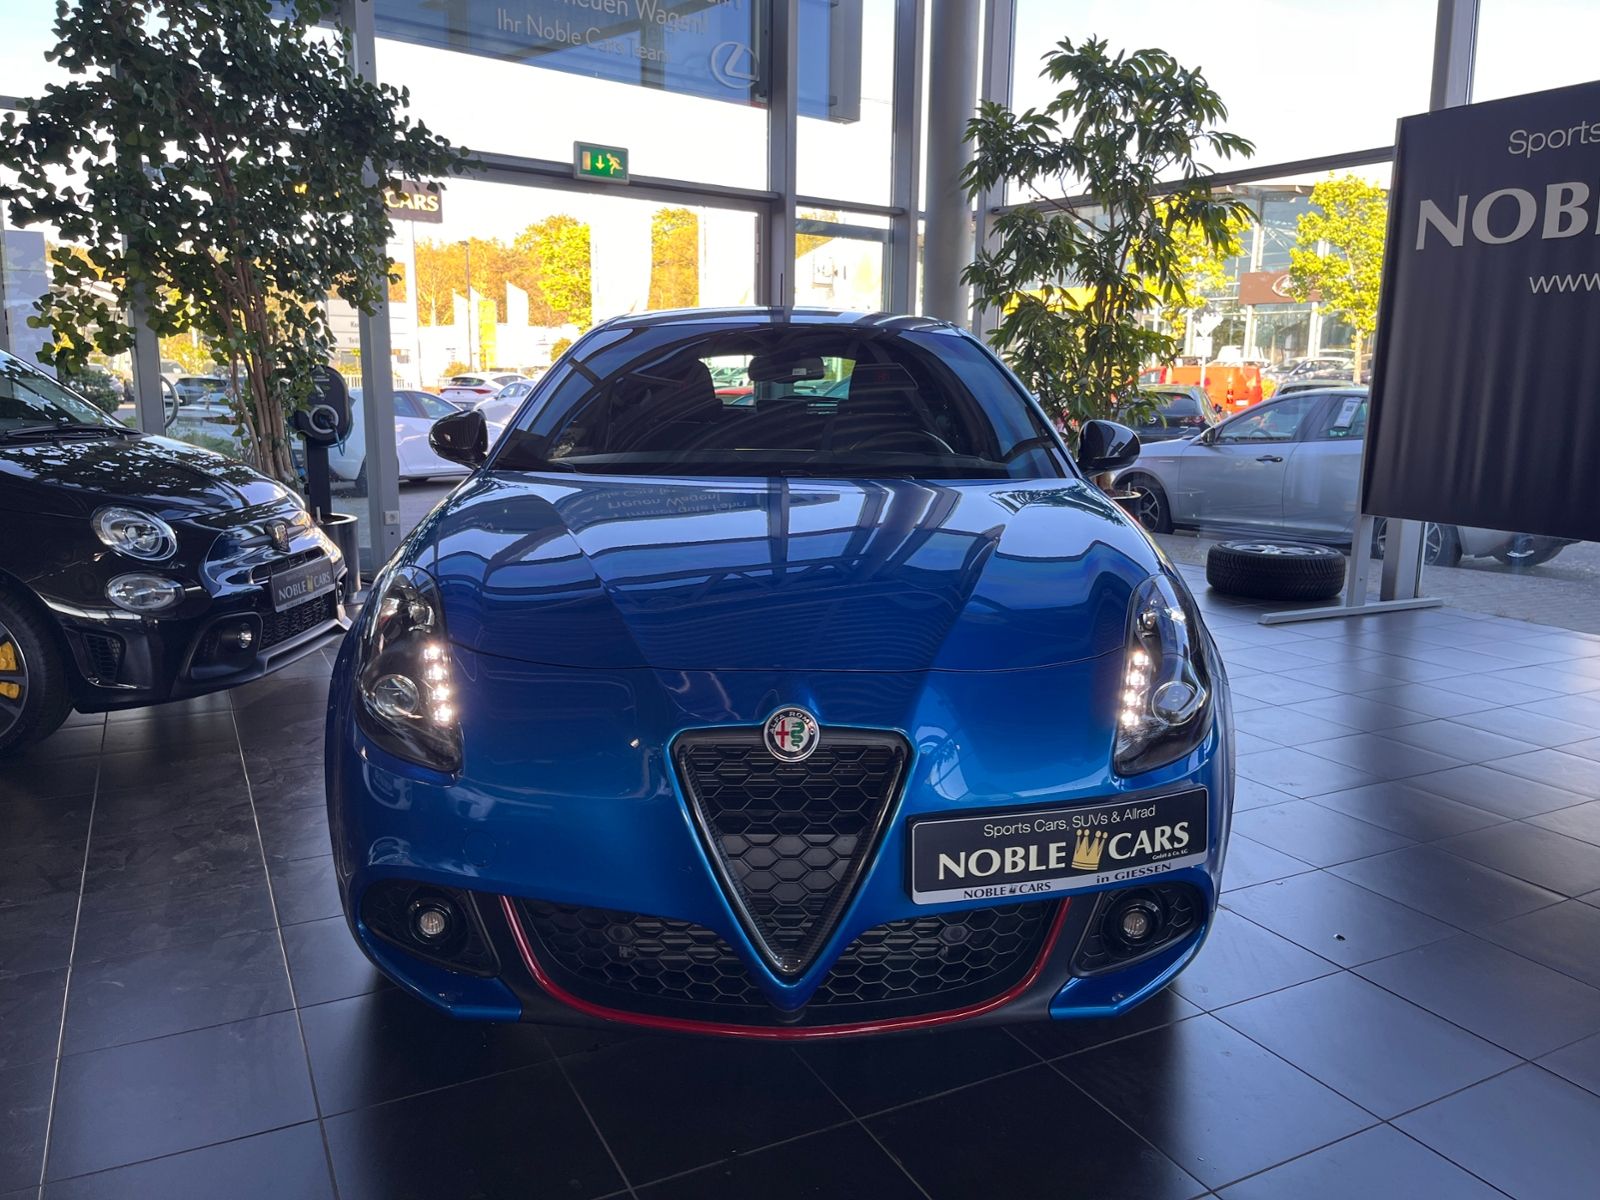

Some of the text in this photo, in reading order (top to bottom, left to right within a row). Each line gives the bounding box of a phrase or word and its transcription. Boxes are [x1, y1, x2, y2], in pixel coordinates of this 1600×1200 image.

[497, 7, 522, 33] Ihr
[527, 14, 582, 45] Noble
[1416, 181, 1600, 250] NOB
[278, 580, 307, 601] NOBLE
[314, 571, 331, 588] CARS
[983, 804, 1156, 839] Sports Cars, SUVs & Allrad
[938, 821, 1190, 881] NOBLE CARS
[963, 881, 1052, 900] NOBLE CARS
[1096, 862, 1172, 885] in GIESSEN
